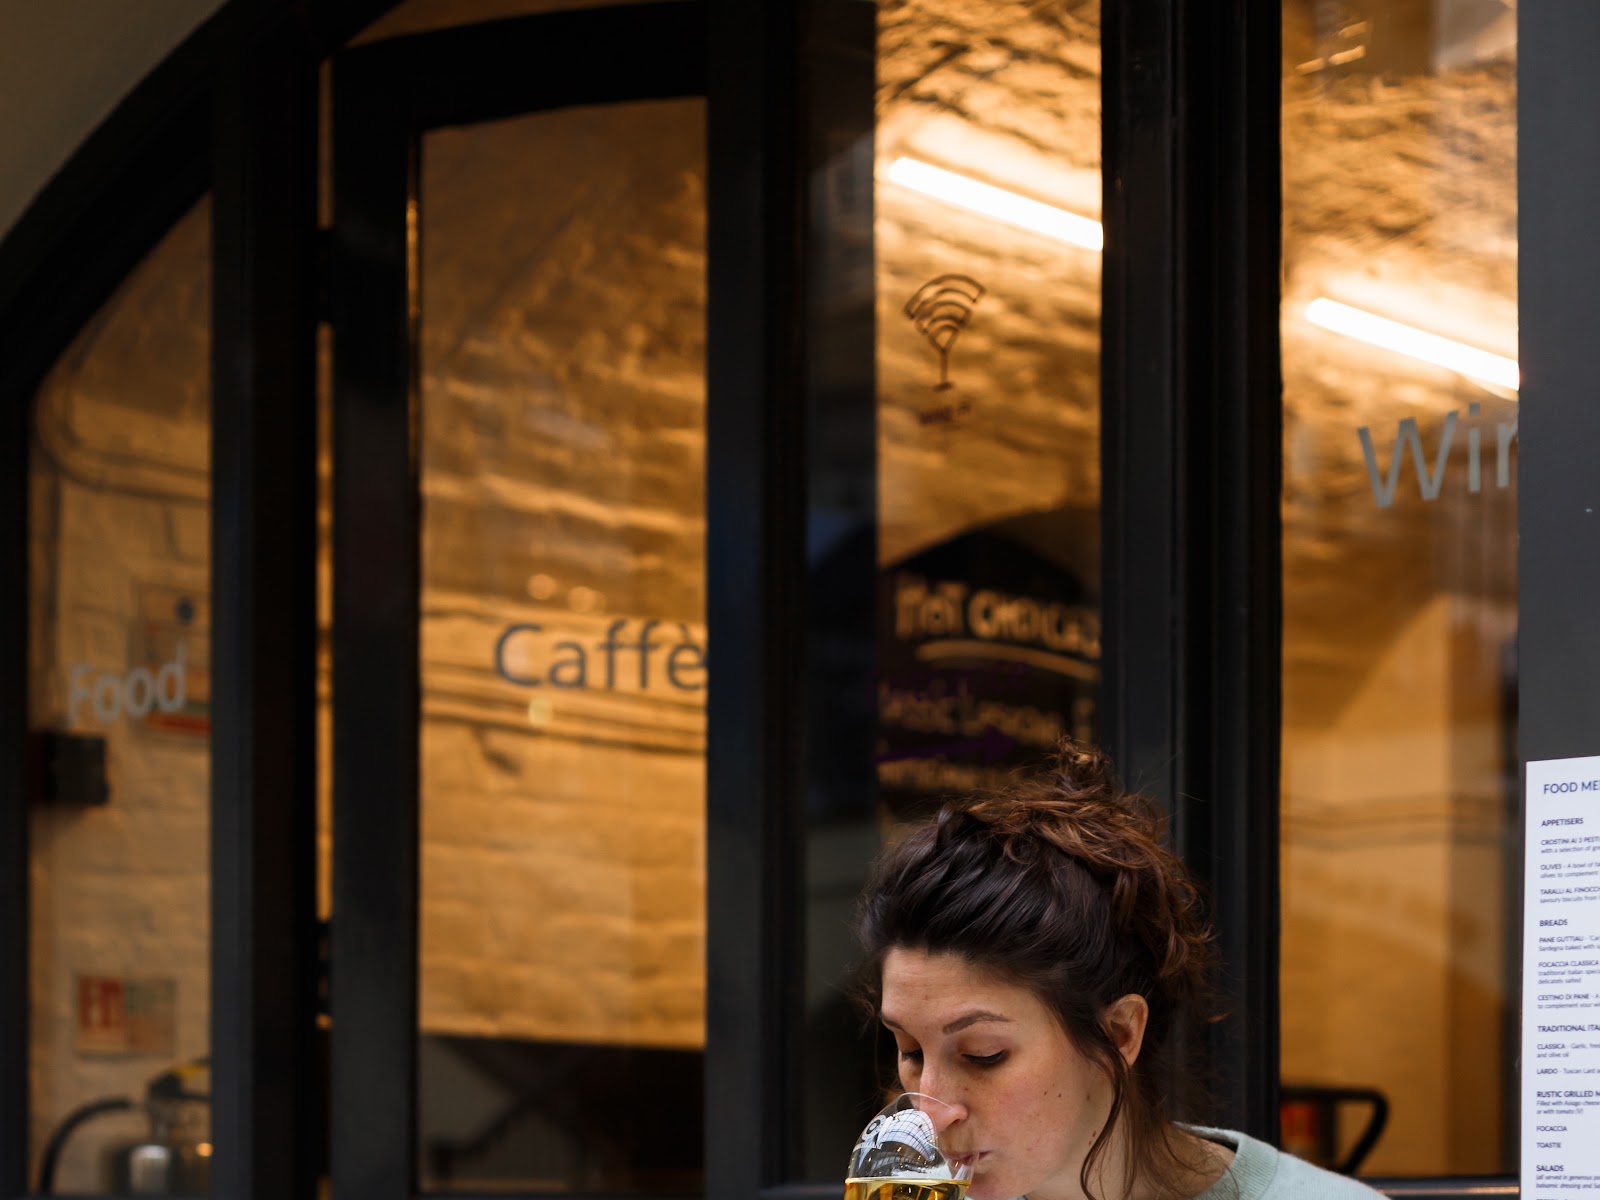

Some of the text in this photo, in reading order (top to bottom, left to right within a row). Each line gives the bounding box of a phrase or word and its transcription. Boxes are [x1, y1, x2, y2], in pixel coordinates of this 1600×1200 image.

[495, 619, 707, 691] Caffè
[69, 640, 187, 730] Food
[1543, 782, 1578, 794] FOOD
[1541, 817, 1584, 827] APPETISERS
[1539, 919, 1568, 927] BREADS
[1564, 1090, 1593, 1098] GRILLED
